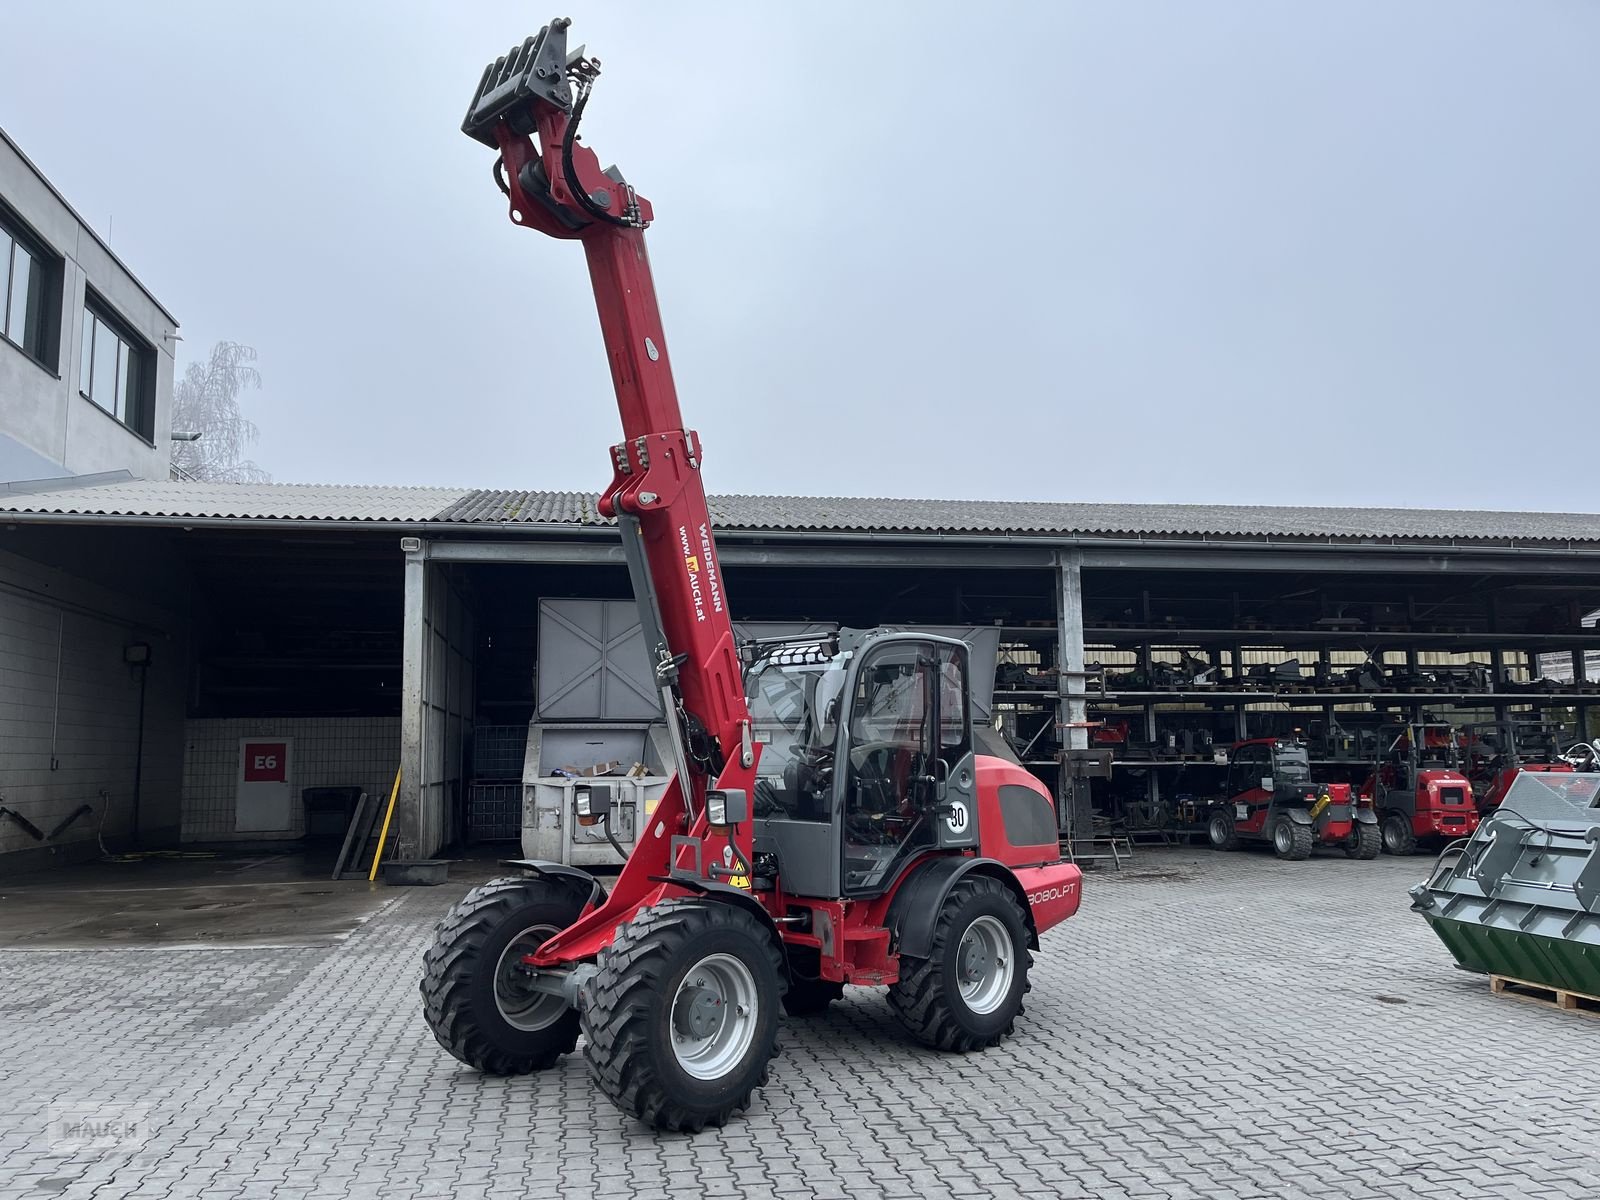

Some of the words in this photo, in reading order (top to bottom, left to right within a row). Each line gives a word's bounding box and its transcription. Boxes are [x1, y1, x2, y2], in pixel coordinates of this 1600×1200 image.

[699, 523, 722, 613] WEIDEMANN
[254, 755, 277, 770] E6
[951, 807, 964, 827] 30
